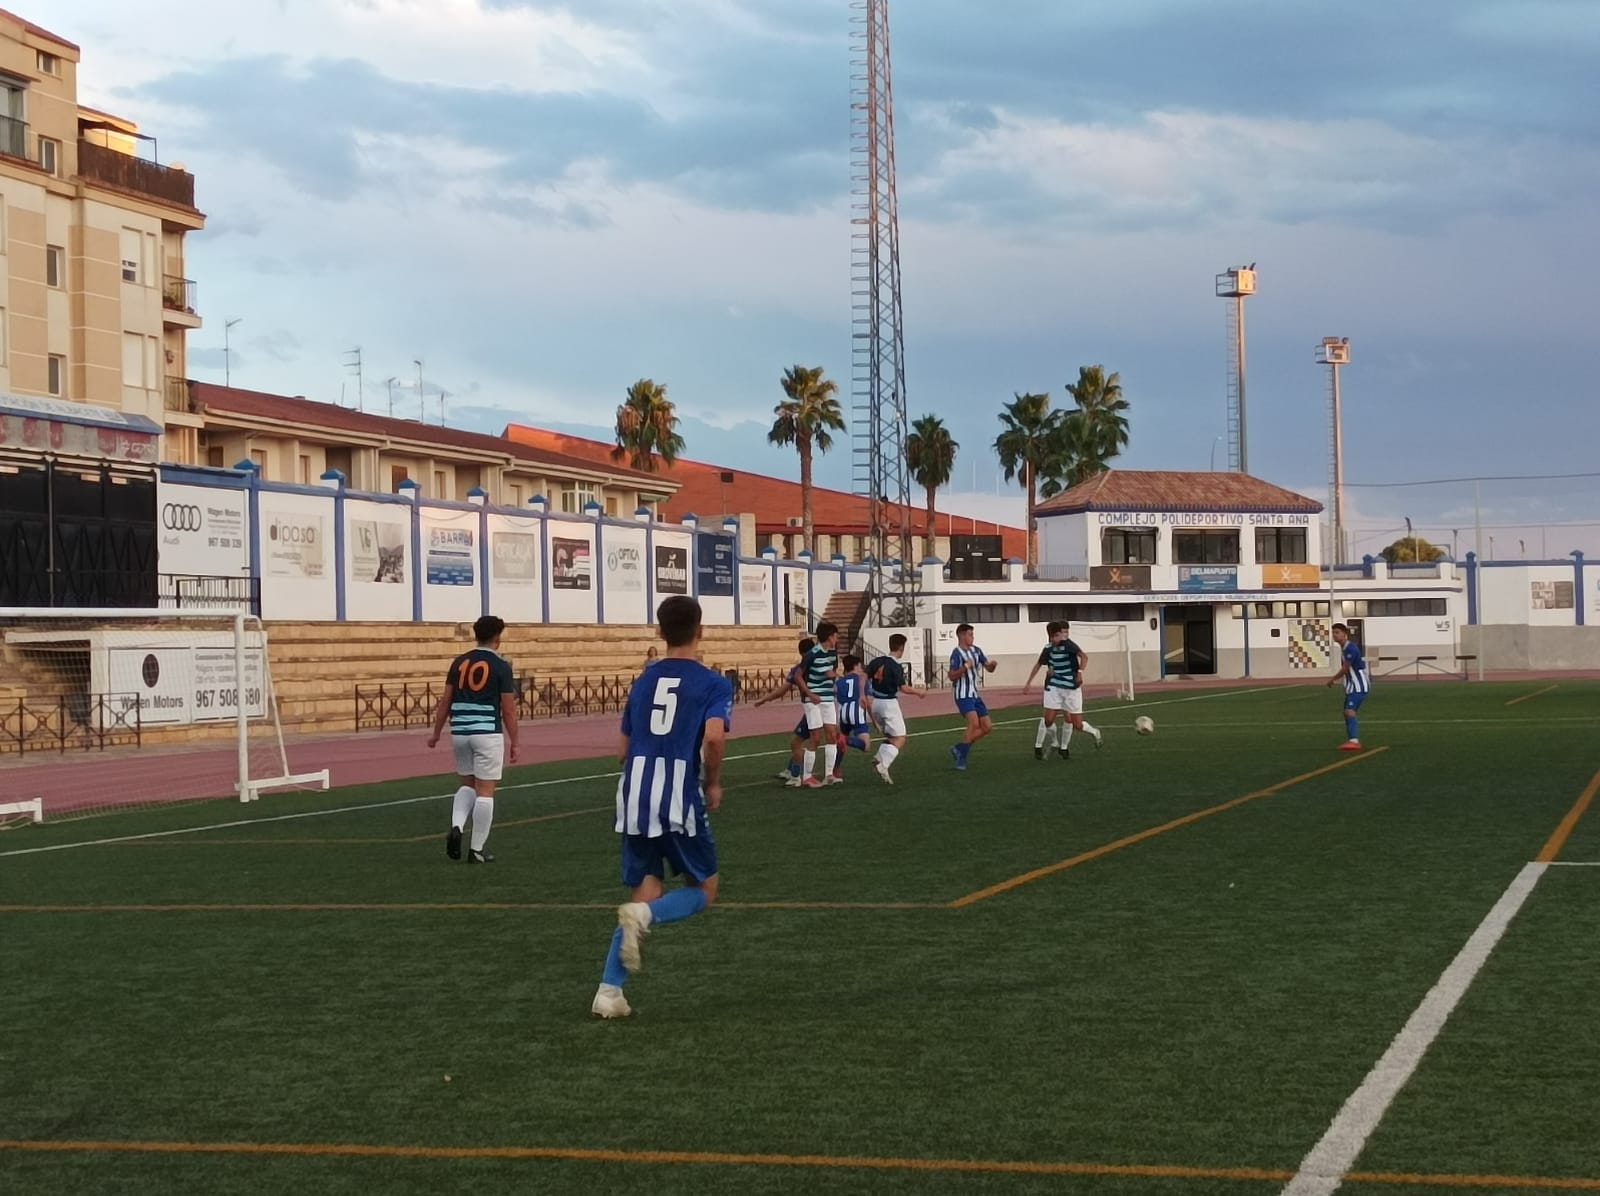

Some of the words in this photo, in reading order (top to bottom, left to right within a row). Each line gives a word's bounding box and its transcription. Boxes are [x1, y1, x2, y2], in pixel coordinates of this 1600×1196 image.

[1098, 513, 1156, 525] COMPLEJO
[1162, 513, 1244, 525] POLIDEPORTIVO
[1248, 514, 1284, 525] SANTA
[1288, 514, 1310, 525] ANA
[618, 548, 640, 561] OPTICA
[458, 658, 491, 693] 10
[153, 695, 183, 709] Motors
[195, 690, 215, 708] 967
[219, 689, 238, 707] 508
[650, 677, 681, 735] 5
